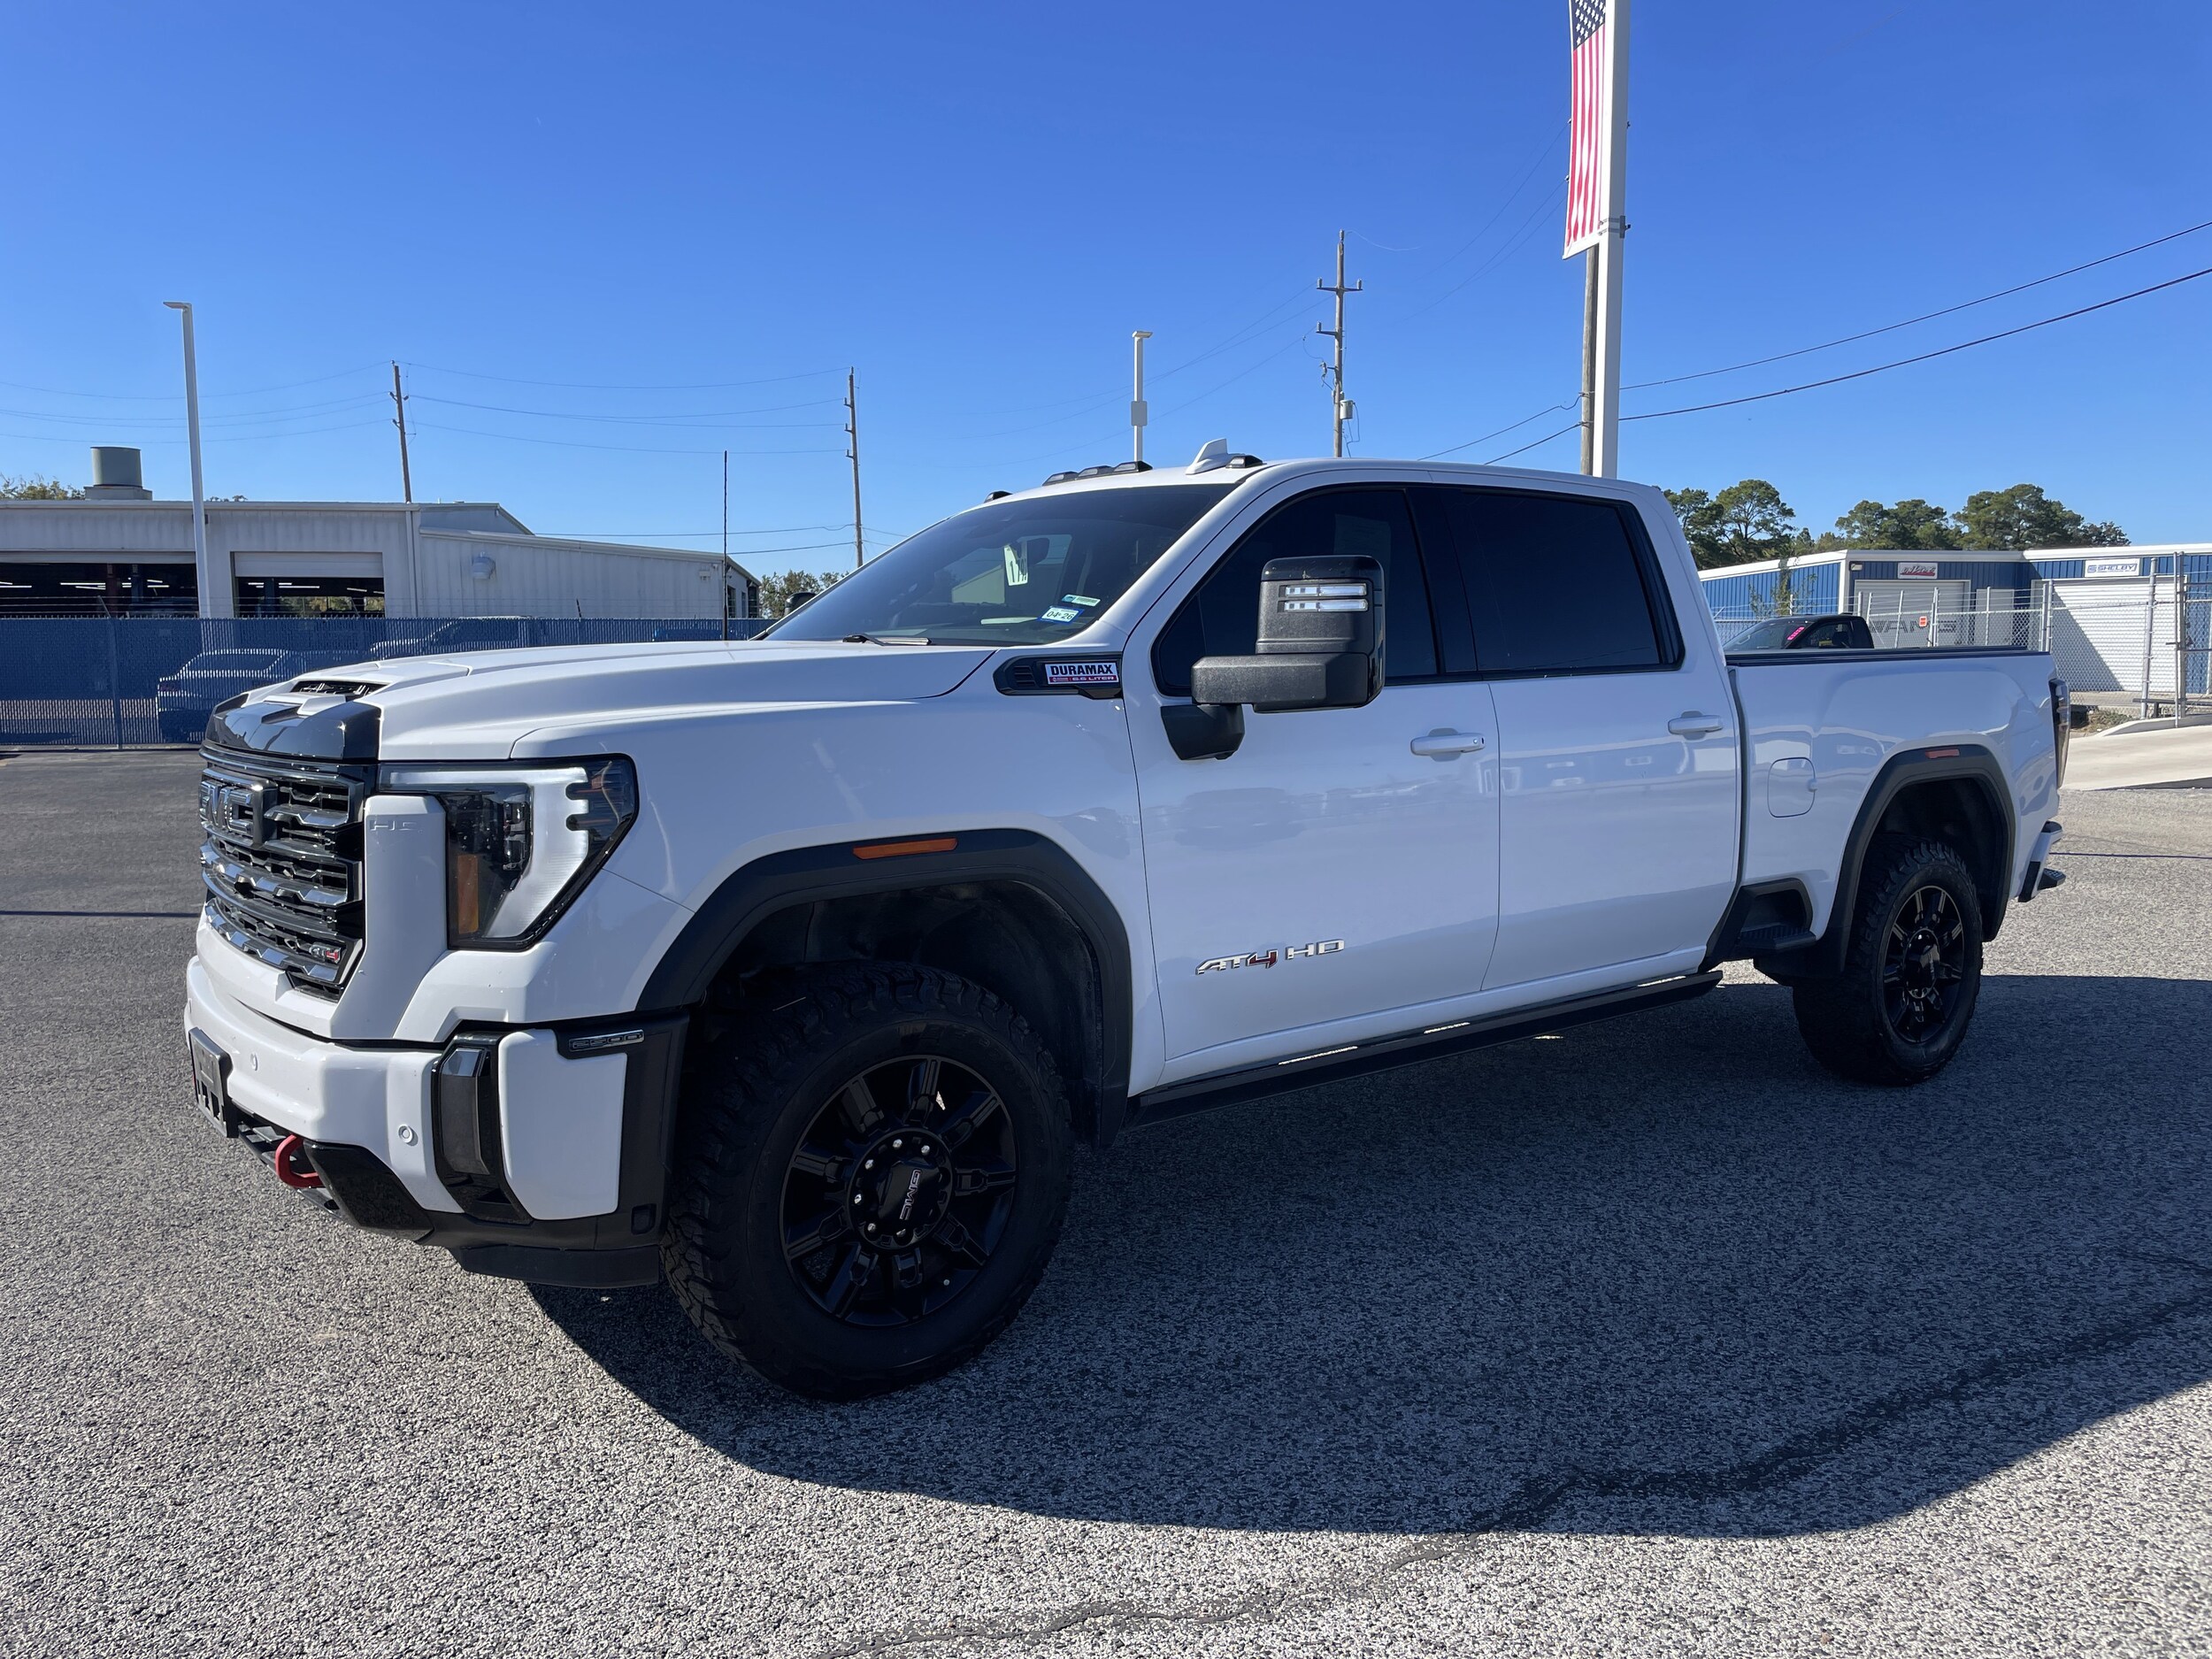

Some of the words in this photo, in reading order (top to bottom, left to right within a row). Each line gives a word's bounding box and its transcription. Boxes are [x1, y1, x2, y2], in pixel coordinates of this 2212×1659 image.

[2098, 564, 2138, 572] SHELBY
[1050, 664, 1114, 675] DURAMAX
[1195, 949, 1279, 975] AT4
[1286, 939, 1345, 960] HD
[572, 1033, 641, 1049] 2500
[899, 1169, 922, 1221] GMC
